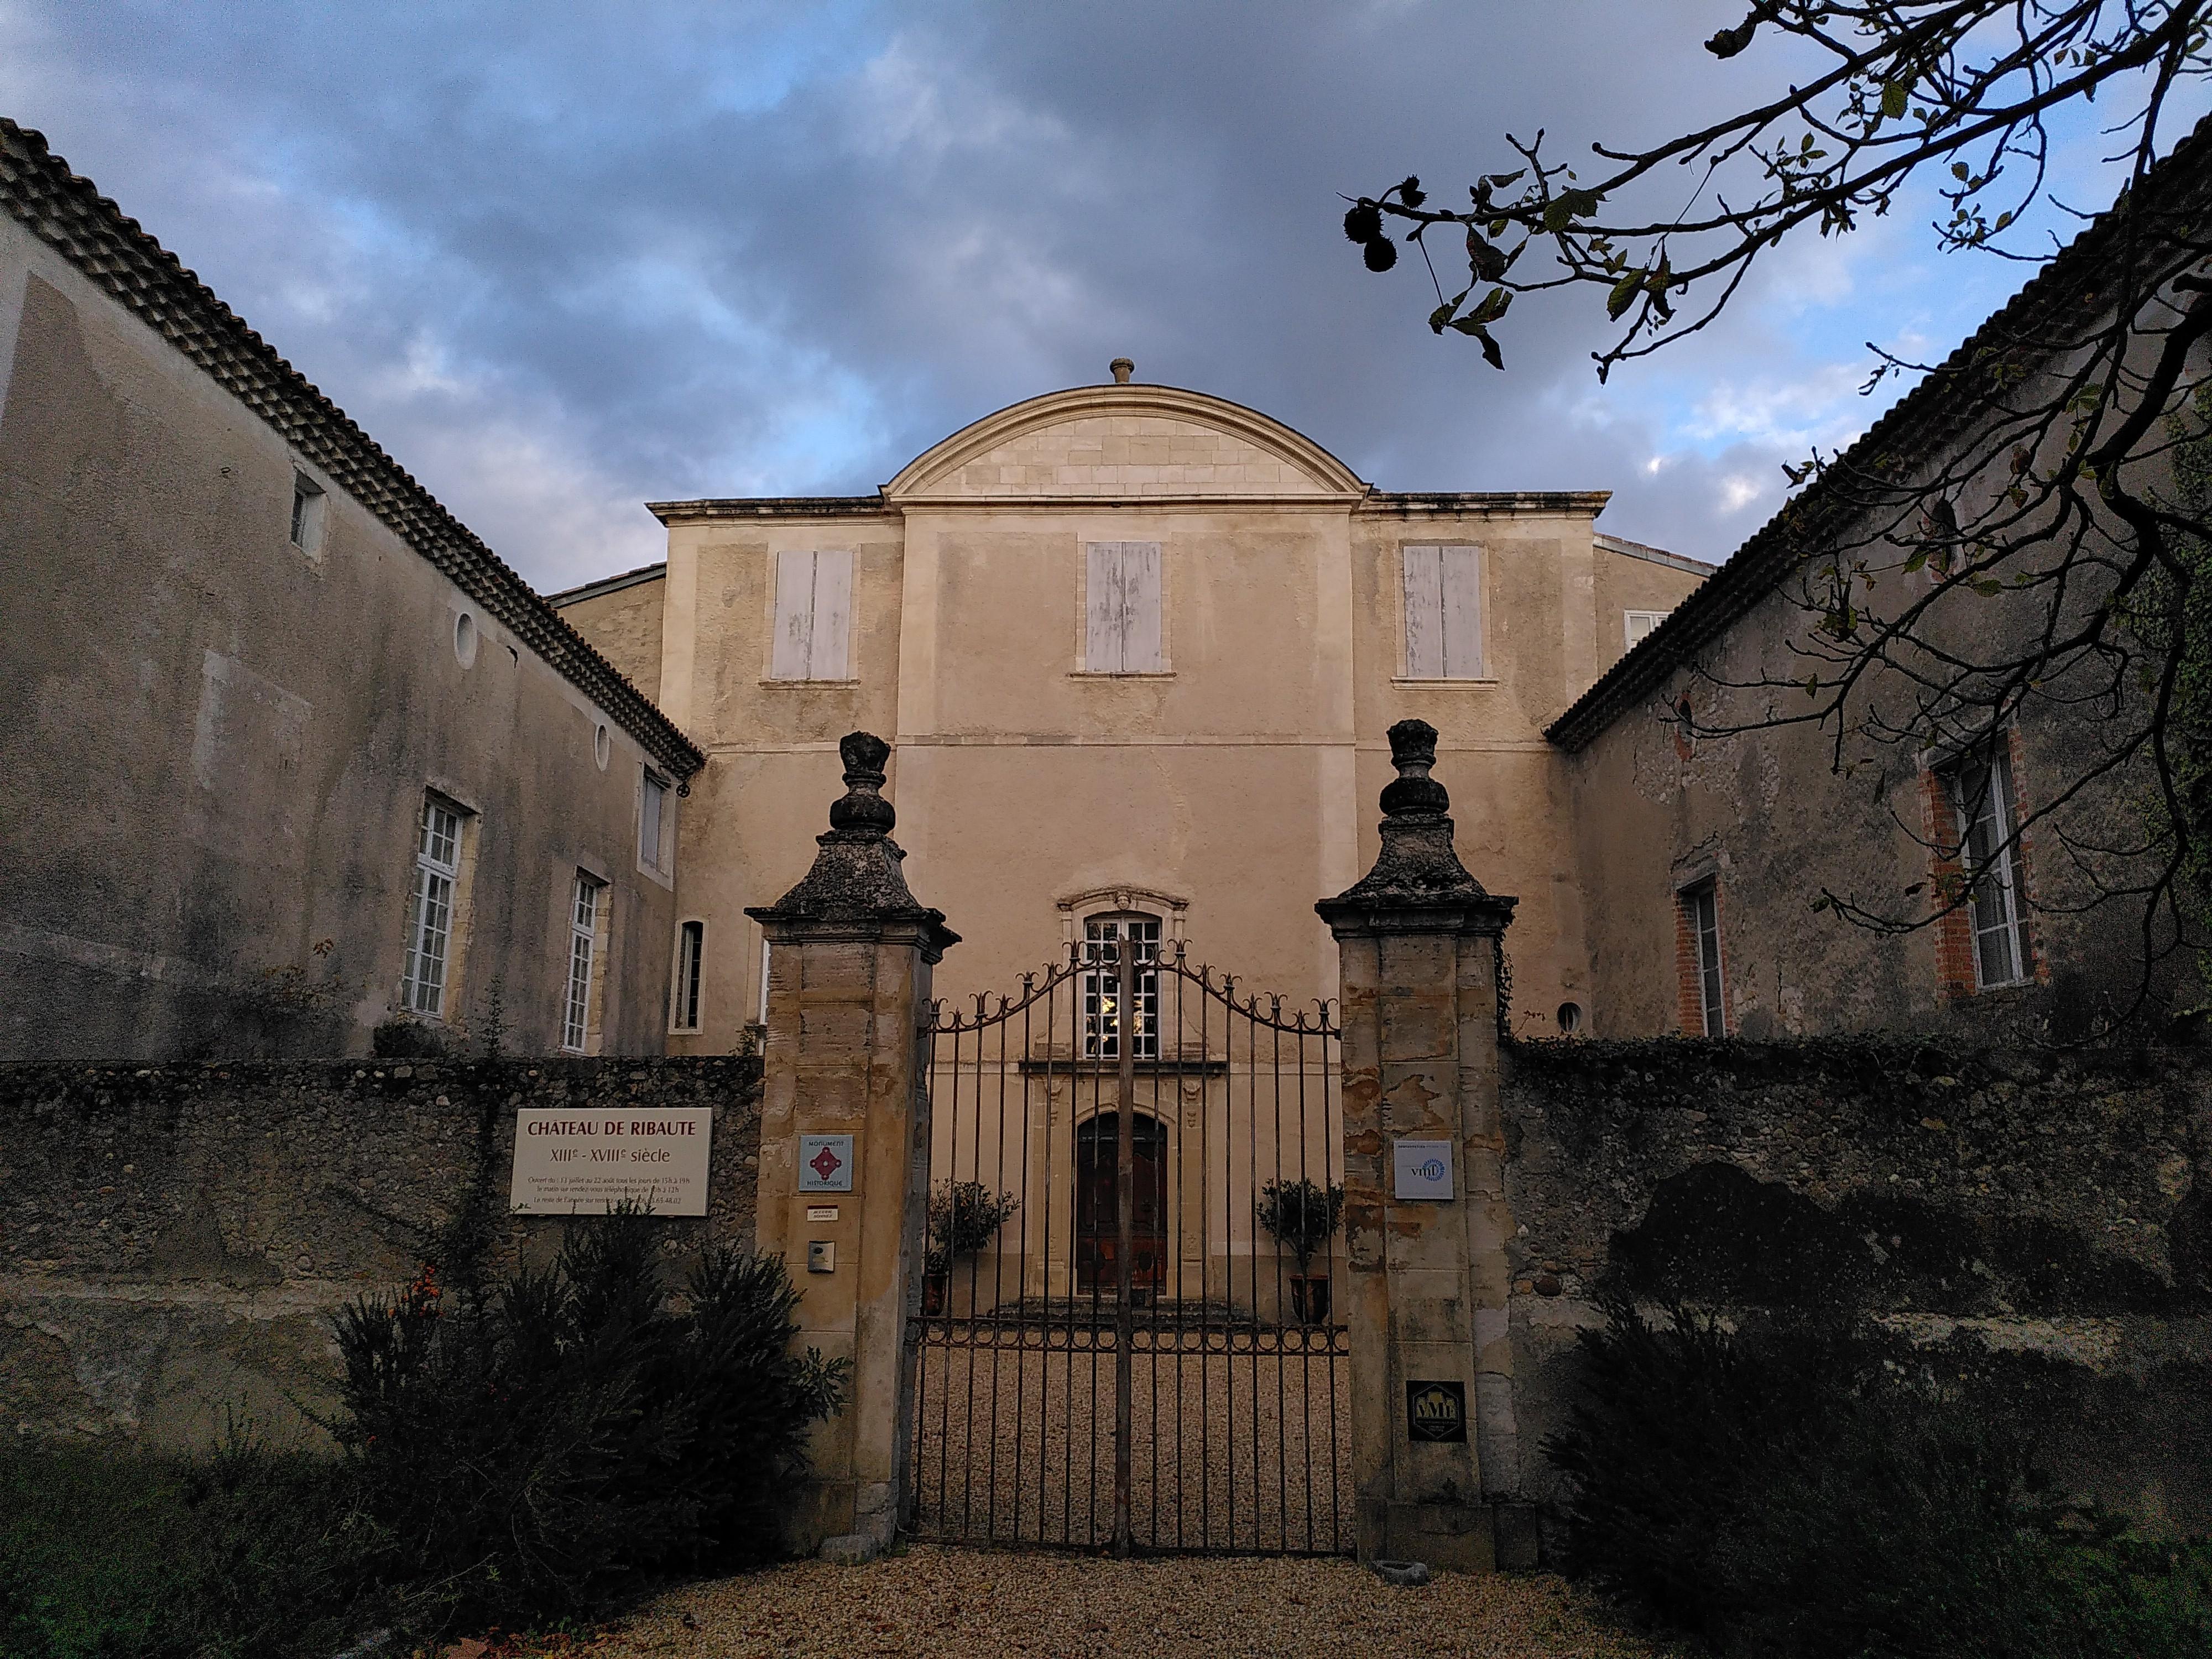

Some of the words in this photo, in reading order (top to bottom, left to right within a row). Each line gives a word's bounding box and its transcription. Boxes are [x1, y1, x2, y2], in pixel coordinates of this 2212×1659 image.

[528, 1119, 598, 1135] CHÂTEAU
[604, 1121, 625, 1135] DE
[630, 1121, 696, 1135] RIBAUTE
[630, 1147, 670, 1162] siècle
[568, 1176, 584, 1185] juillet
